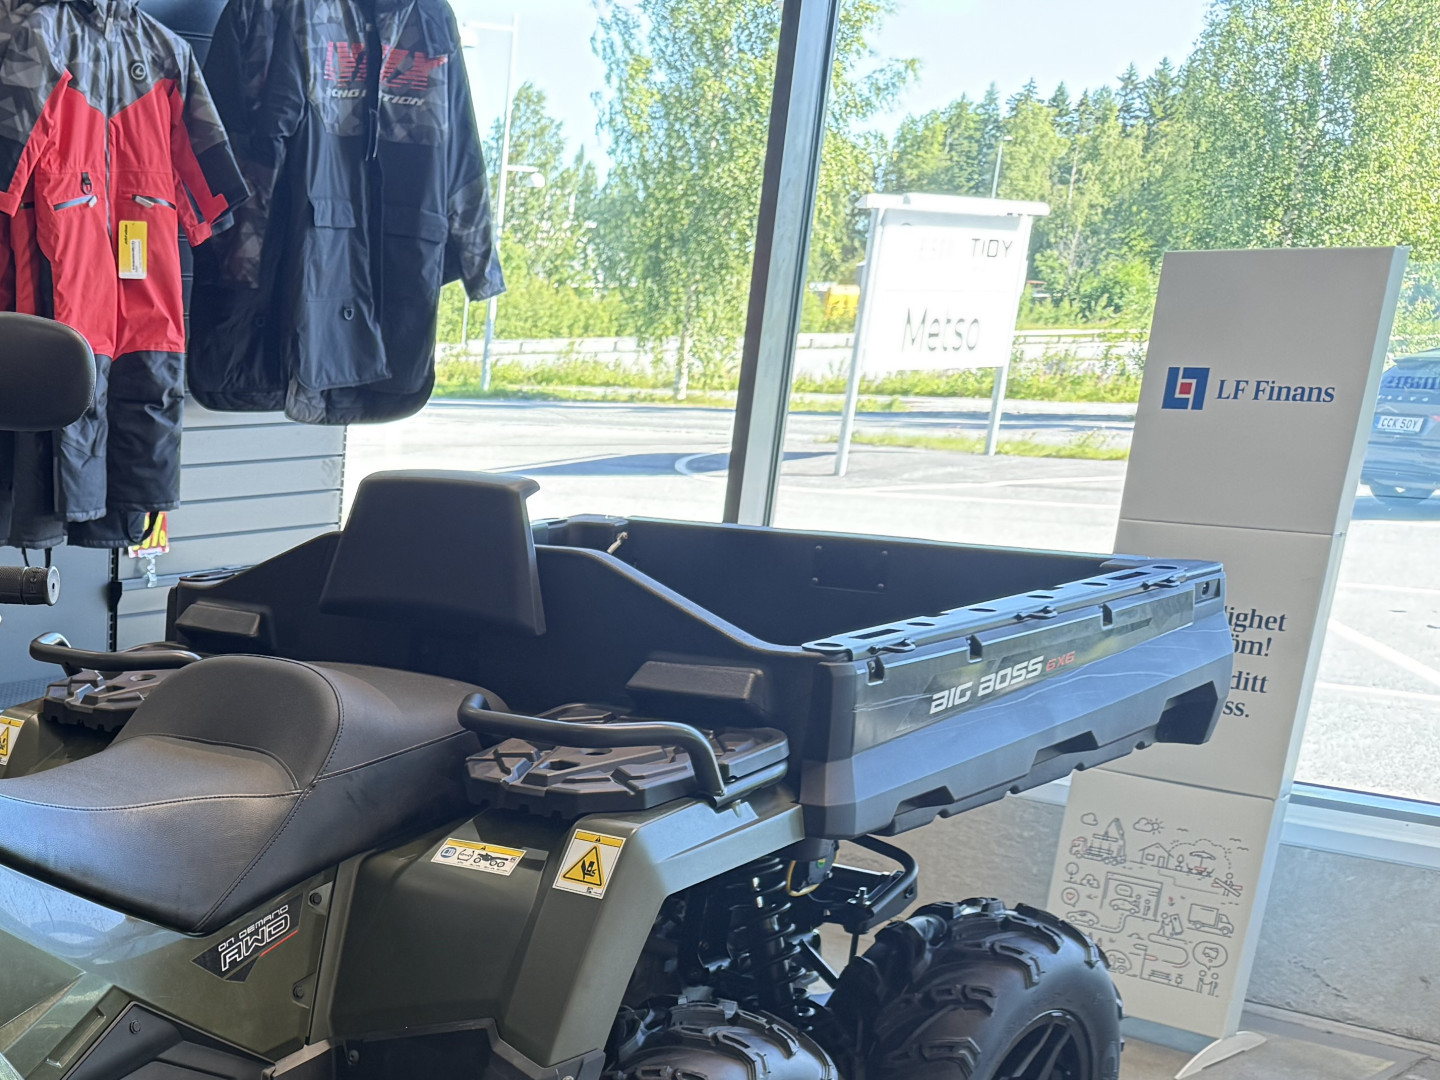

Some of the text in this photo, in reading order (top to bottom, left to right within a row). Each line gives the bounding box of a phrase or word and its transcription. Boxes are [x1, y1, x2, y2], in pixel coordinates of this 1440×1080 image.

[971, 237, 1014, 258] TIDY
[901, 306, 981, 352] Metso
[1216, 379, 1336, 403] LF Finans
[1224, 605, 1288, 633] ighet
[929, 681, 974, 715] BIG
[977, 655, 1045, 697] BOSS
[220, 912, 291, 972] AWD
